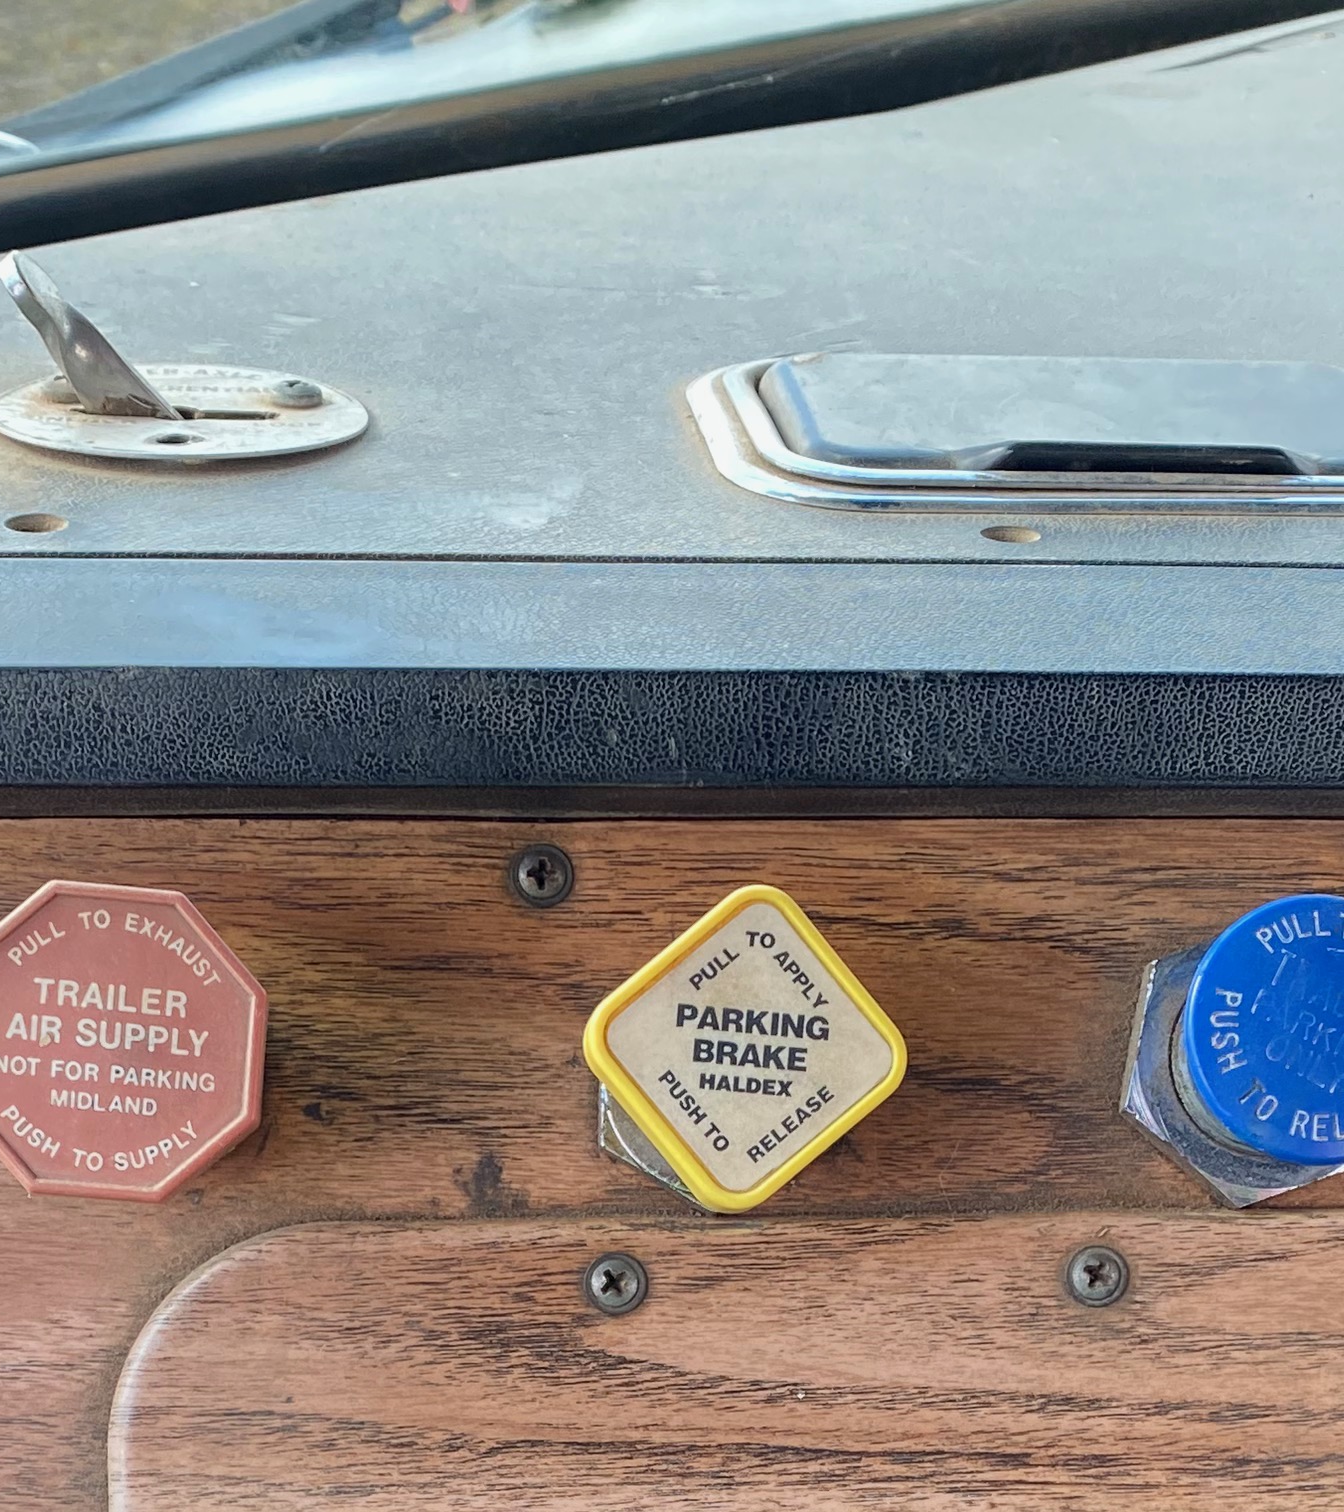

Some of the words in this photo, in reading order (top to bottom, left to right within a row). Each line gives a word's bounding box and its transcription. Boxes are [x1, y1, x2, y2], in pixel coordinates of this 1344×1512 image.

[7, 921, 66, 967] PULL
[78, 909, 111, 931] TO
[124, 913, 221, 987] EXHAUST
[1255, 911, 1332, 954] PULL
[689, 947, 740, 991] PULL
[745, 930, 776, 949] TO
[773, 951, 830, 1010] APPLY
[33, 977, 188, 1018] TRAILER
[5, 1013, 62, 1045] AIR
[75, 1018, 209, 1058] SUPPLY
[676, 1003, 830, 1041] PARKING
[692, 1038, 808, 1072] BRAKE
[1209, 987, 1248, 1075] PUSH
[1238, 1077, 1279, 1122] TO
[50, 1060, 99, 1083] FOR
[110, 1064, 216, 1093] PARKING
[699, 1073, 793, 1097] HALDEX
[50, 1089, 158, 1117] MIDLAND
[658, 1069, 706, 1126] PUSH
[704, 1122, 730, 1153] TO
[746, 1085, 836, 1164] RELEASE
[0, 1104, 61, 1158] PUSH
[72, 1148, 104, 1172] TO
[113, 1120, 198, 1172] SUPPLY
